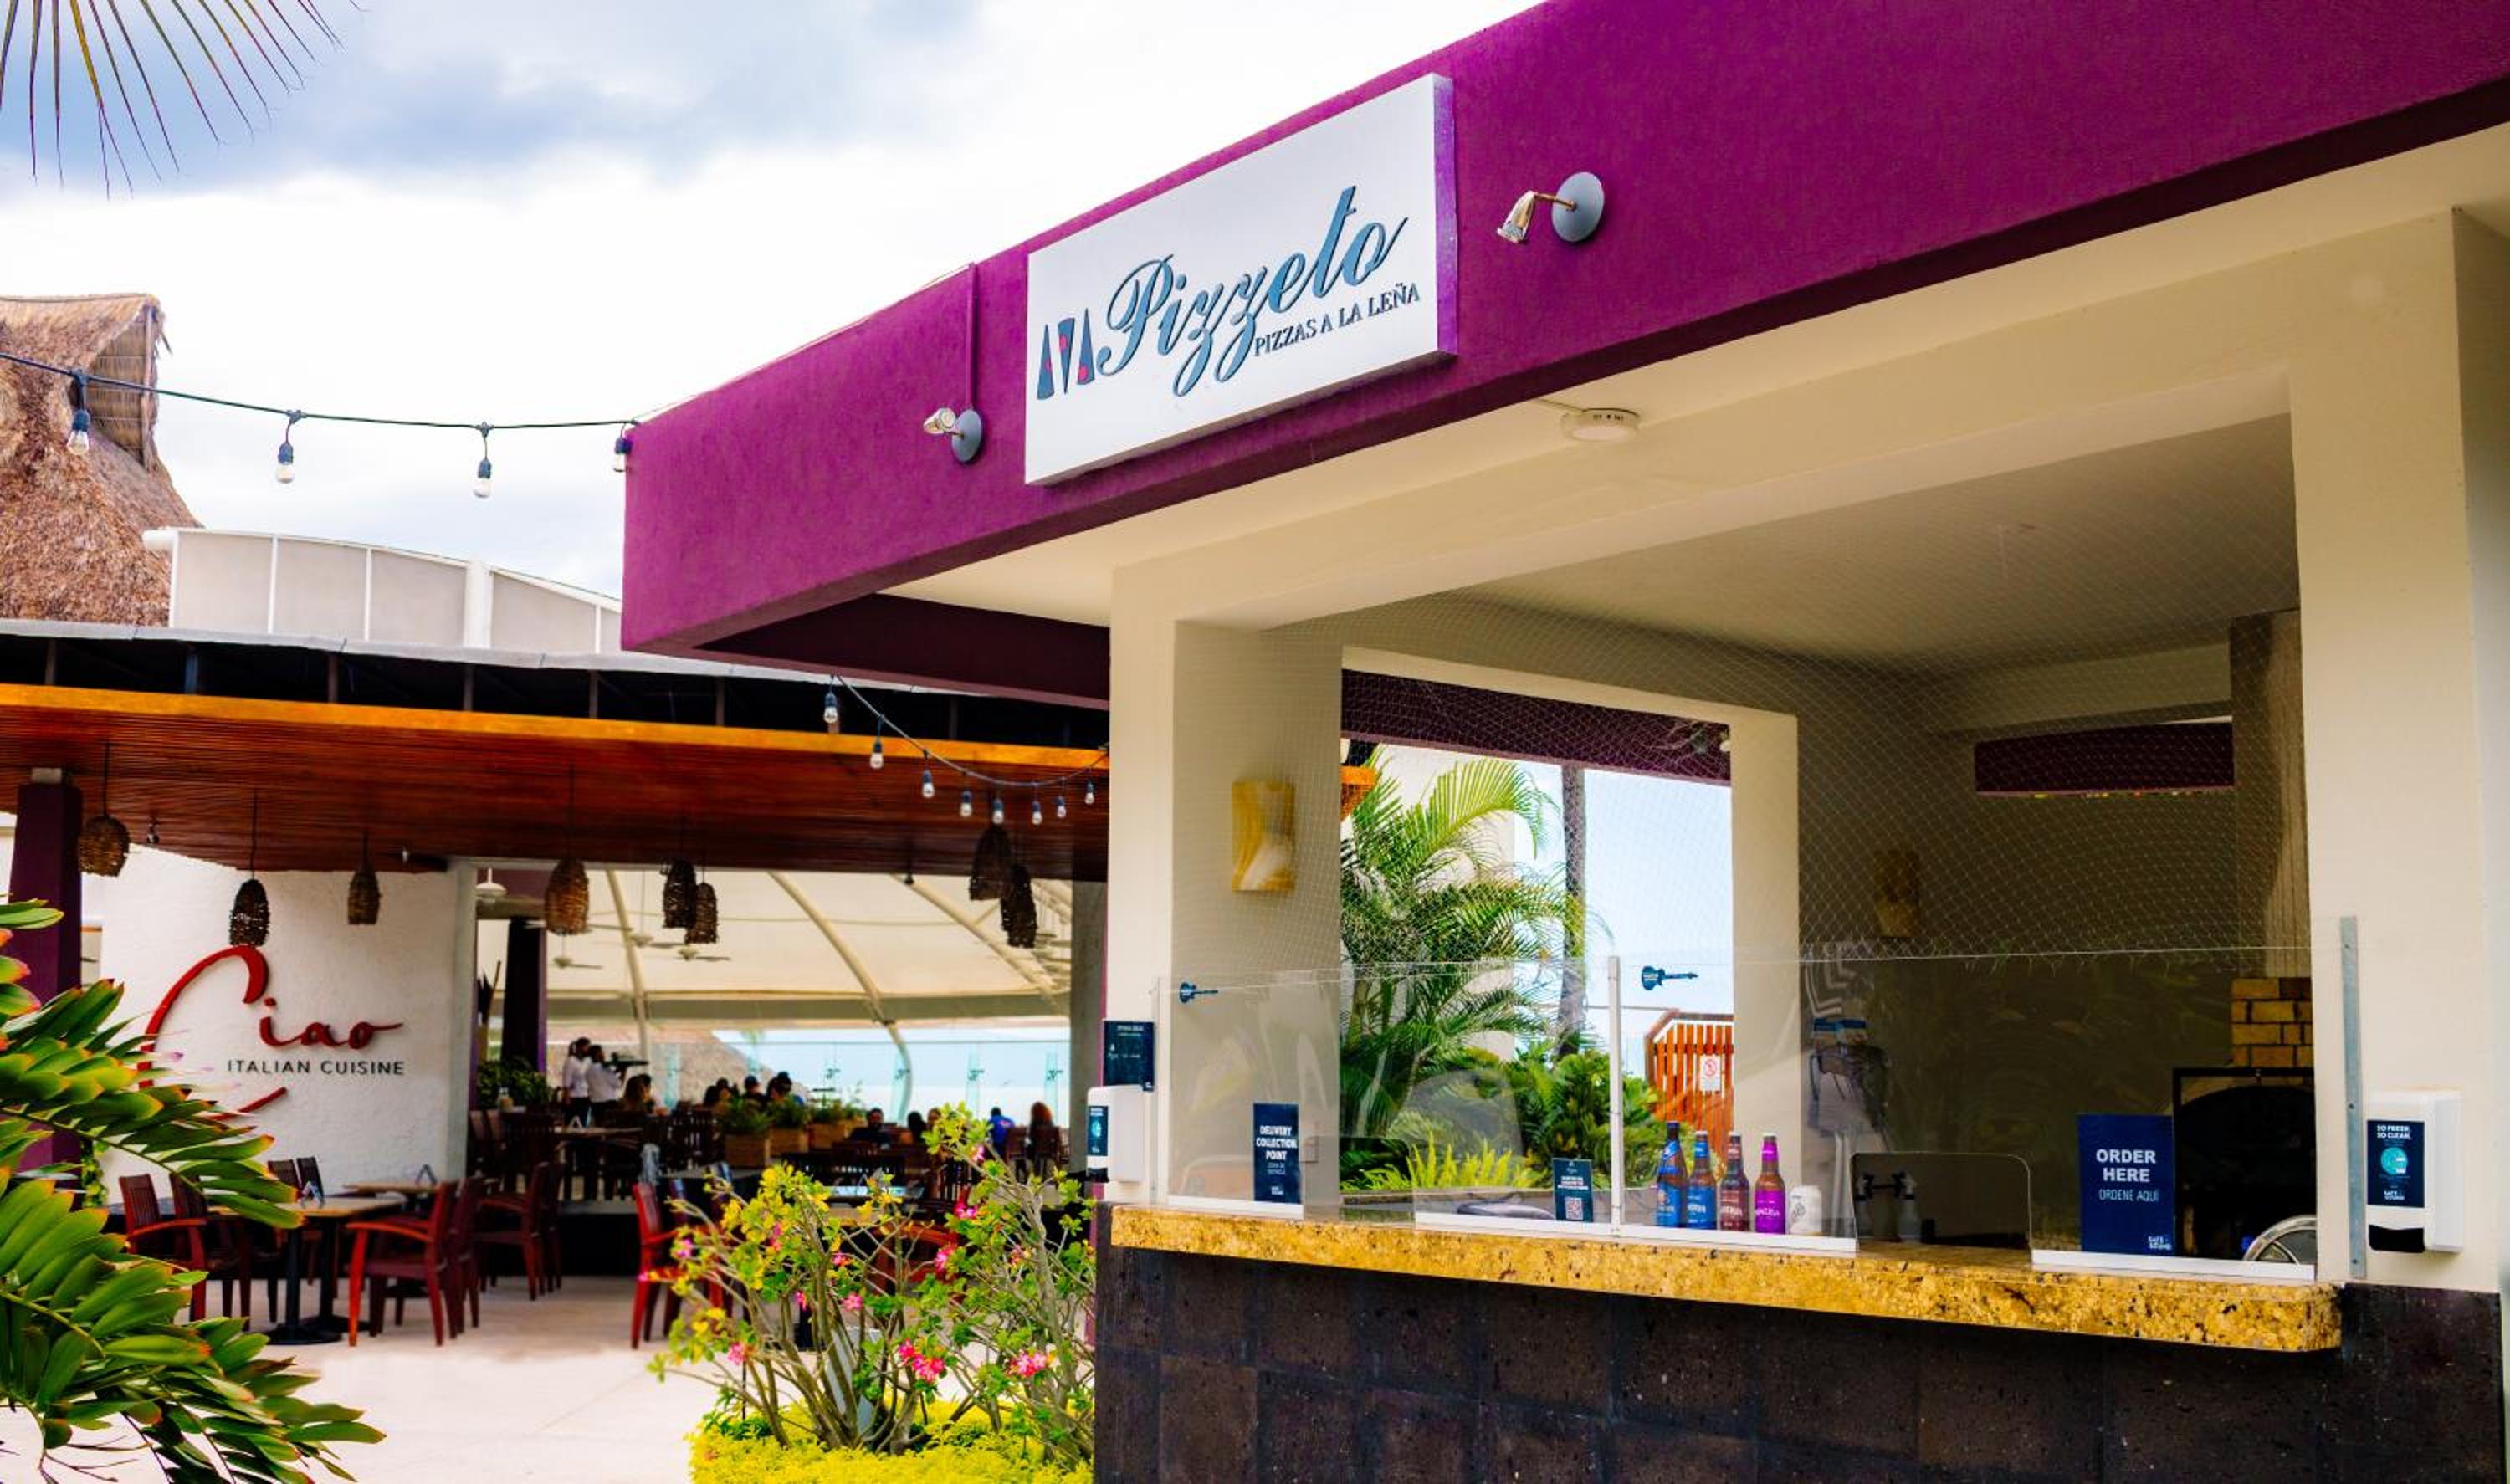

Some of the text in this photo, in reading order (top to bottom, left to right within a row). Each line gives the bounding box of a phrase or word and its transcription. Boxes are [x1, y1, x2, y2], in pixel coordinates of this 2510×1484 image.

[1096, 185, 1409, 397] Pizzeto
[1253, 281, 1420, 356] PIZZAS A LA LEÑA
[137, 944, 403, 1121] Ciao
[227, 1059, 404, 1076] ITALIAN CUISINE
[1259, 1125, 1293, 1136] DELIVERY
[1256, 1137, 1298, 1149] COLLECTION
[1266, 1149, 1288, 1160] POINT
[2096, 1149, 2157, 1164] ORDER
[2103, 1167, 2151, 1182] HERE
[2098, 1189, 2134, 1201] ORDENE
